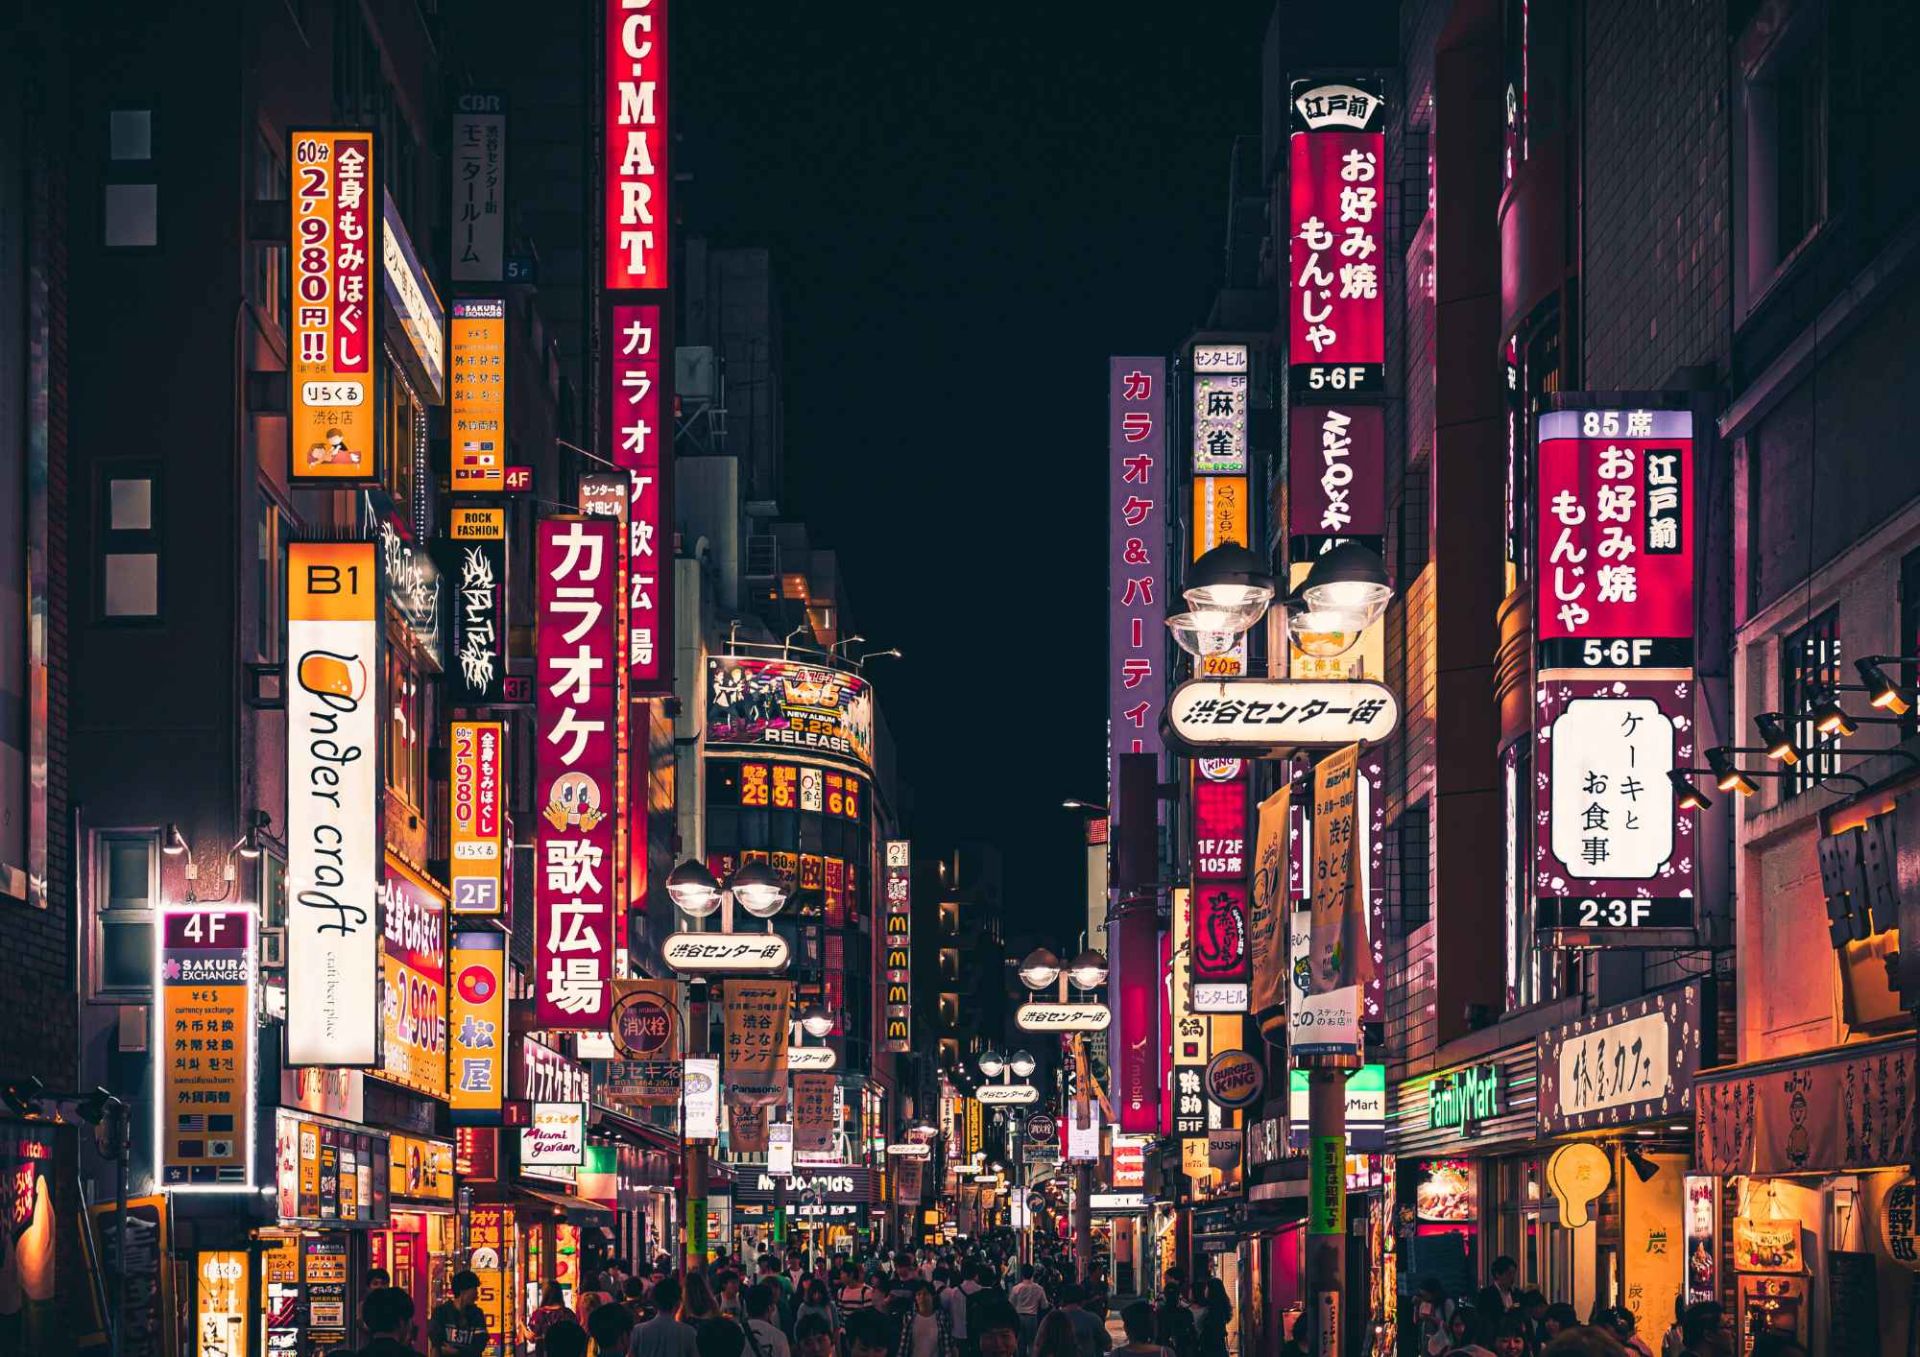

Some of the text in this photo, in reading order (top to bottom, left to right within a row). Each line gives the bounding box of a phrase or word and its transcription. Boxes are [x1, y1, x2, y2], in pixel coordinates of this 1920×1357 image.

[459, 95, 499, 111] CBR
[1304, 94, 1369, 119] 江戸前
[617, 0, 656, 275] C-MART
[297, 141, 330, 163] 60分
[460, 124, 483, 264] モニタールーム
[1340, 148, 1378, 299] お好み焼
[300, 167, 329, 363] 2,980円!!
[337, 147, 366, 366] 全身もみほぐし
[1299, 216, 1337, 353] もんじゃ
[465, 304, 502, 312] SAKURA
[1195, 352, 1246, 366] センタービル
[1231, 377, 1246, 387] 5F
[307, 386, 359, 401] りらくる
[313, 411, 353, 425] 渋谷店
[1207, 390, 1234, 456] 麻雀
[1583, 409, 1653, 437] 85席
[507, 471, 529, 487] 4F
[583, 484, 625, 496] センター街
[1649, 454, 1678, 549] 江戸前
[464, 512, 492, 524] ROCK
[1597, 445, 1638, 603] お好み焼
[457, 525, 499, 536] FASHION
[1550, 490, 1589, 632] もんじゃ
[306, 565, 358, 594] B1
[787, 711, 836, 724] NEW ALBUM
[1182, 699, 1388, 725] 渋谷センター街
[790, 718, 833, 735] 5.23
[765, 728, 851, 753] RELEASE
[546, 522, 605, 1014] カラオケ 歌広場
[1207, 757, 1235, 770] KING
[1620, 711, 1645, 830] ケーキと
[481, 731, 493, 832] 全身もみほぐし
[297, 649, 368, 937] Under craft
[1581, 770, 1610, 866] お食事
[1329, 816, 1352, 846] 渋谷
[457, 844, 494, 855] りらくる
[1197, 839, 1243, 854] 1F/2F
[1199, 858, 1243, 873] 105席
[460, 883, 492, 904] 2F
[183, 913, 226, 944] 4F
[385, 879, 443, 969] 全身もみほぐし
[669, 943, 782, 959] 渋谷センター街
[182, 960, 247, 971] SAKURA
[182, 971, 240, 980] EXCHANGE
[1195, 991, 1246, 1004] センタービル
[175, 1007, 234, 1015] currency exchange
[1022, 1011, 1105, 1023] 渋谷センター街
[1292, 1009, 1352, 1028] この ステッカー
[623, 1016, 666, 1036] 消火栓
[743, 1014, 772, 1028] 渋谷
[1179, 1019, 1204, 1036] 鍋
[729, 1032, 784, 1046] おとなり
[458, 1016, 496, 1092] 松屋
[728, 1049, 785, 1062] サンデー
[1213, 1063, 1253, 1081] BURGER
[732, 1084, 782, 1095] Panasonic
[1215, 1073, 1255, 1094] KING
[1428, 1064, 1498, 1137] FamilyMart
[523, 1128, 568, 1140] Miami
[1178, 1121, 1203, 1132] B1F
